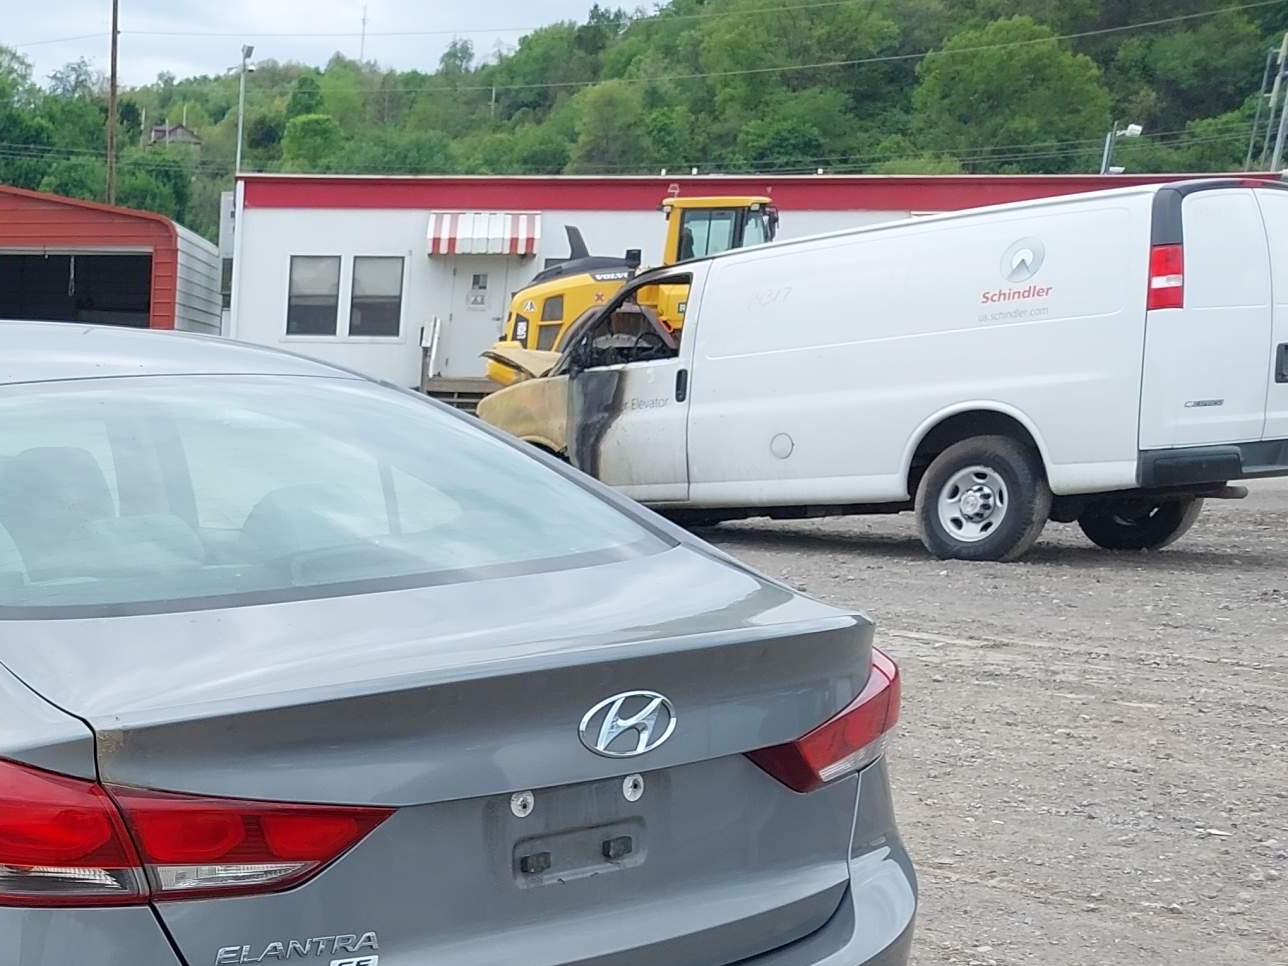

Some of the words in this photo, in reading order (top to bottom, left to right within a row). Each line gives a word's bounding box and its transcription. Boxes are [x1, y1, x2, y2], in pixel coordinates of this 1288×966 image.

[980, 285, 1053, 304] Schindler
[632, 398, 669, 410] Elevator
[214, 931, 379, 966] ELANTRA
